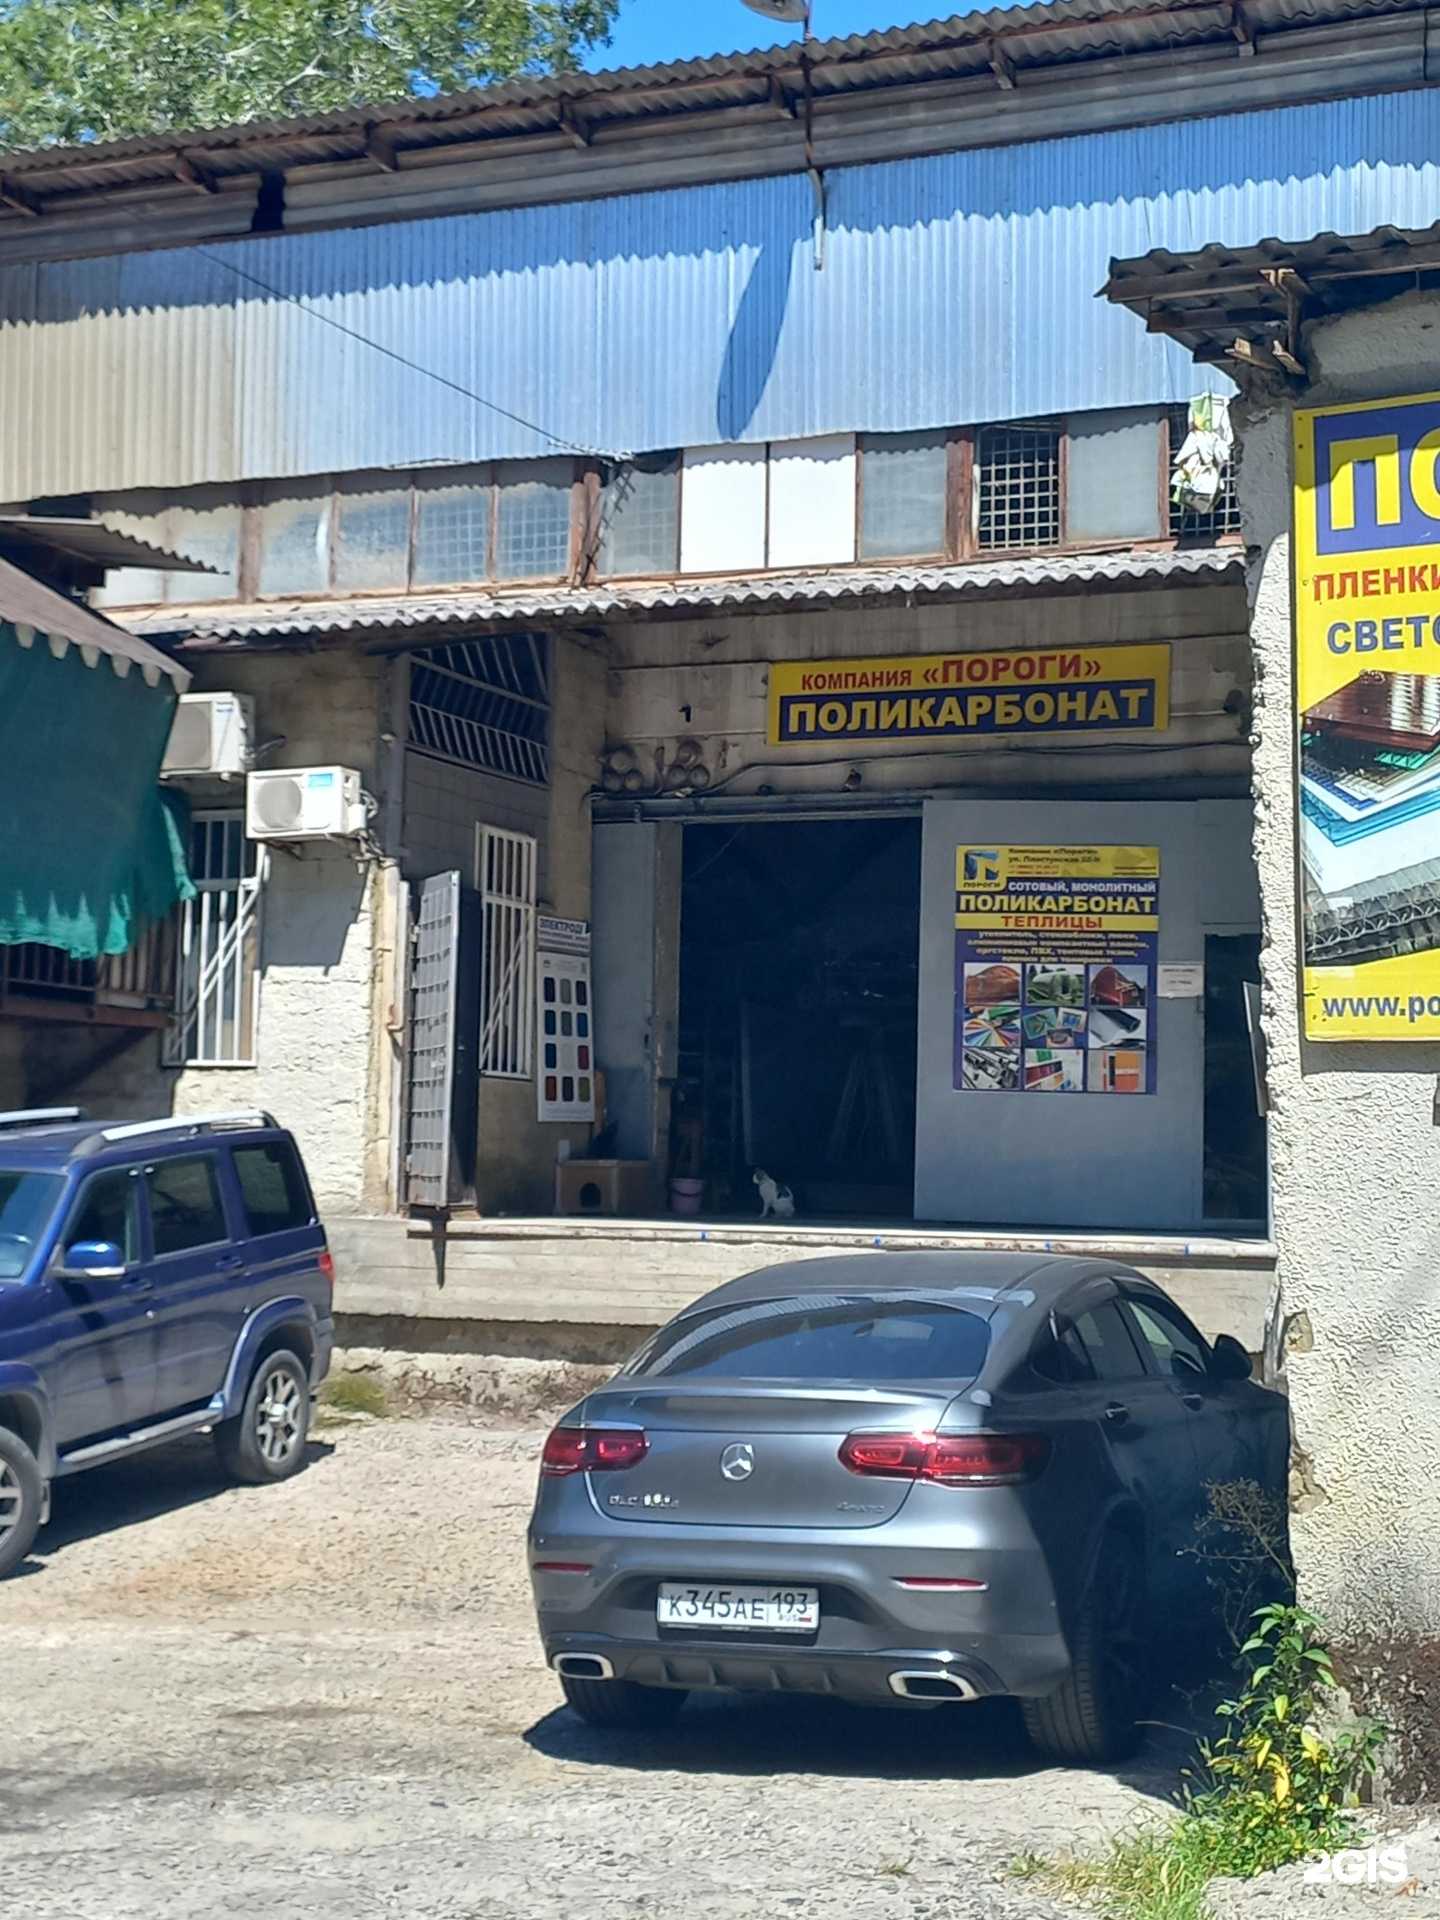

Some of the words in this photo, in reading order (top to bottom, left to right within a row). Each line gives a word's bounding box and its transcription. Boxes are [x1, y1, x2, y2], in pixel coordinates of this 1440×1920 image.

[1327, 614, 1440, 654] СВЕТ
[802, 670, 912, 690] КОМПАНИЯ
[923, 655, 1101, 684] «ПОРОГИ»
[788, 688, 1148, 733] ПОЛИКАРБОНАТ
[959, 895, 1155, 913] ПОЛИКАРБОНАТ
[1001, 915, 1103, 929] ТЕПЛИЦЫ
[772, 1592, 808, 1614] 193
